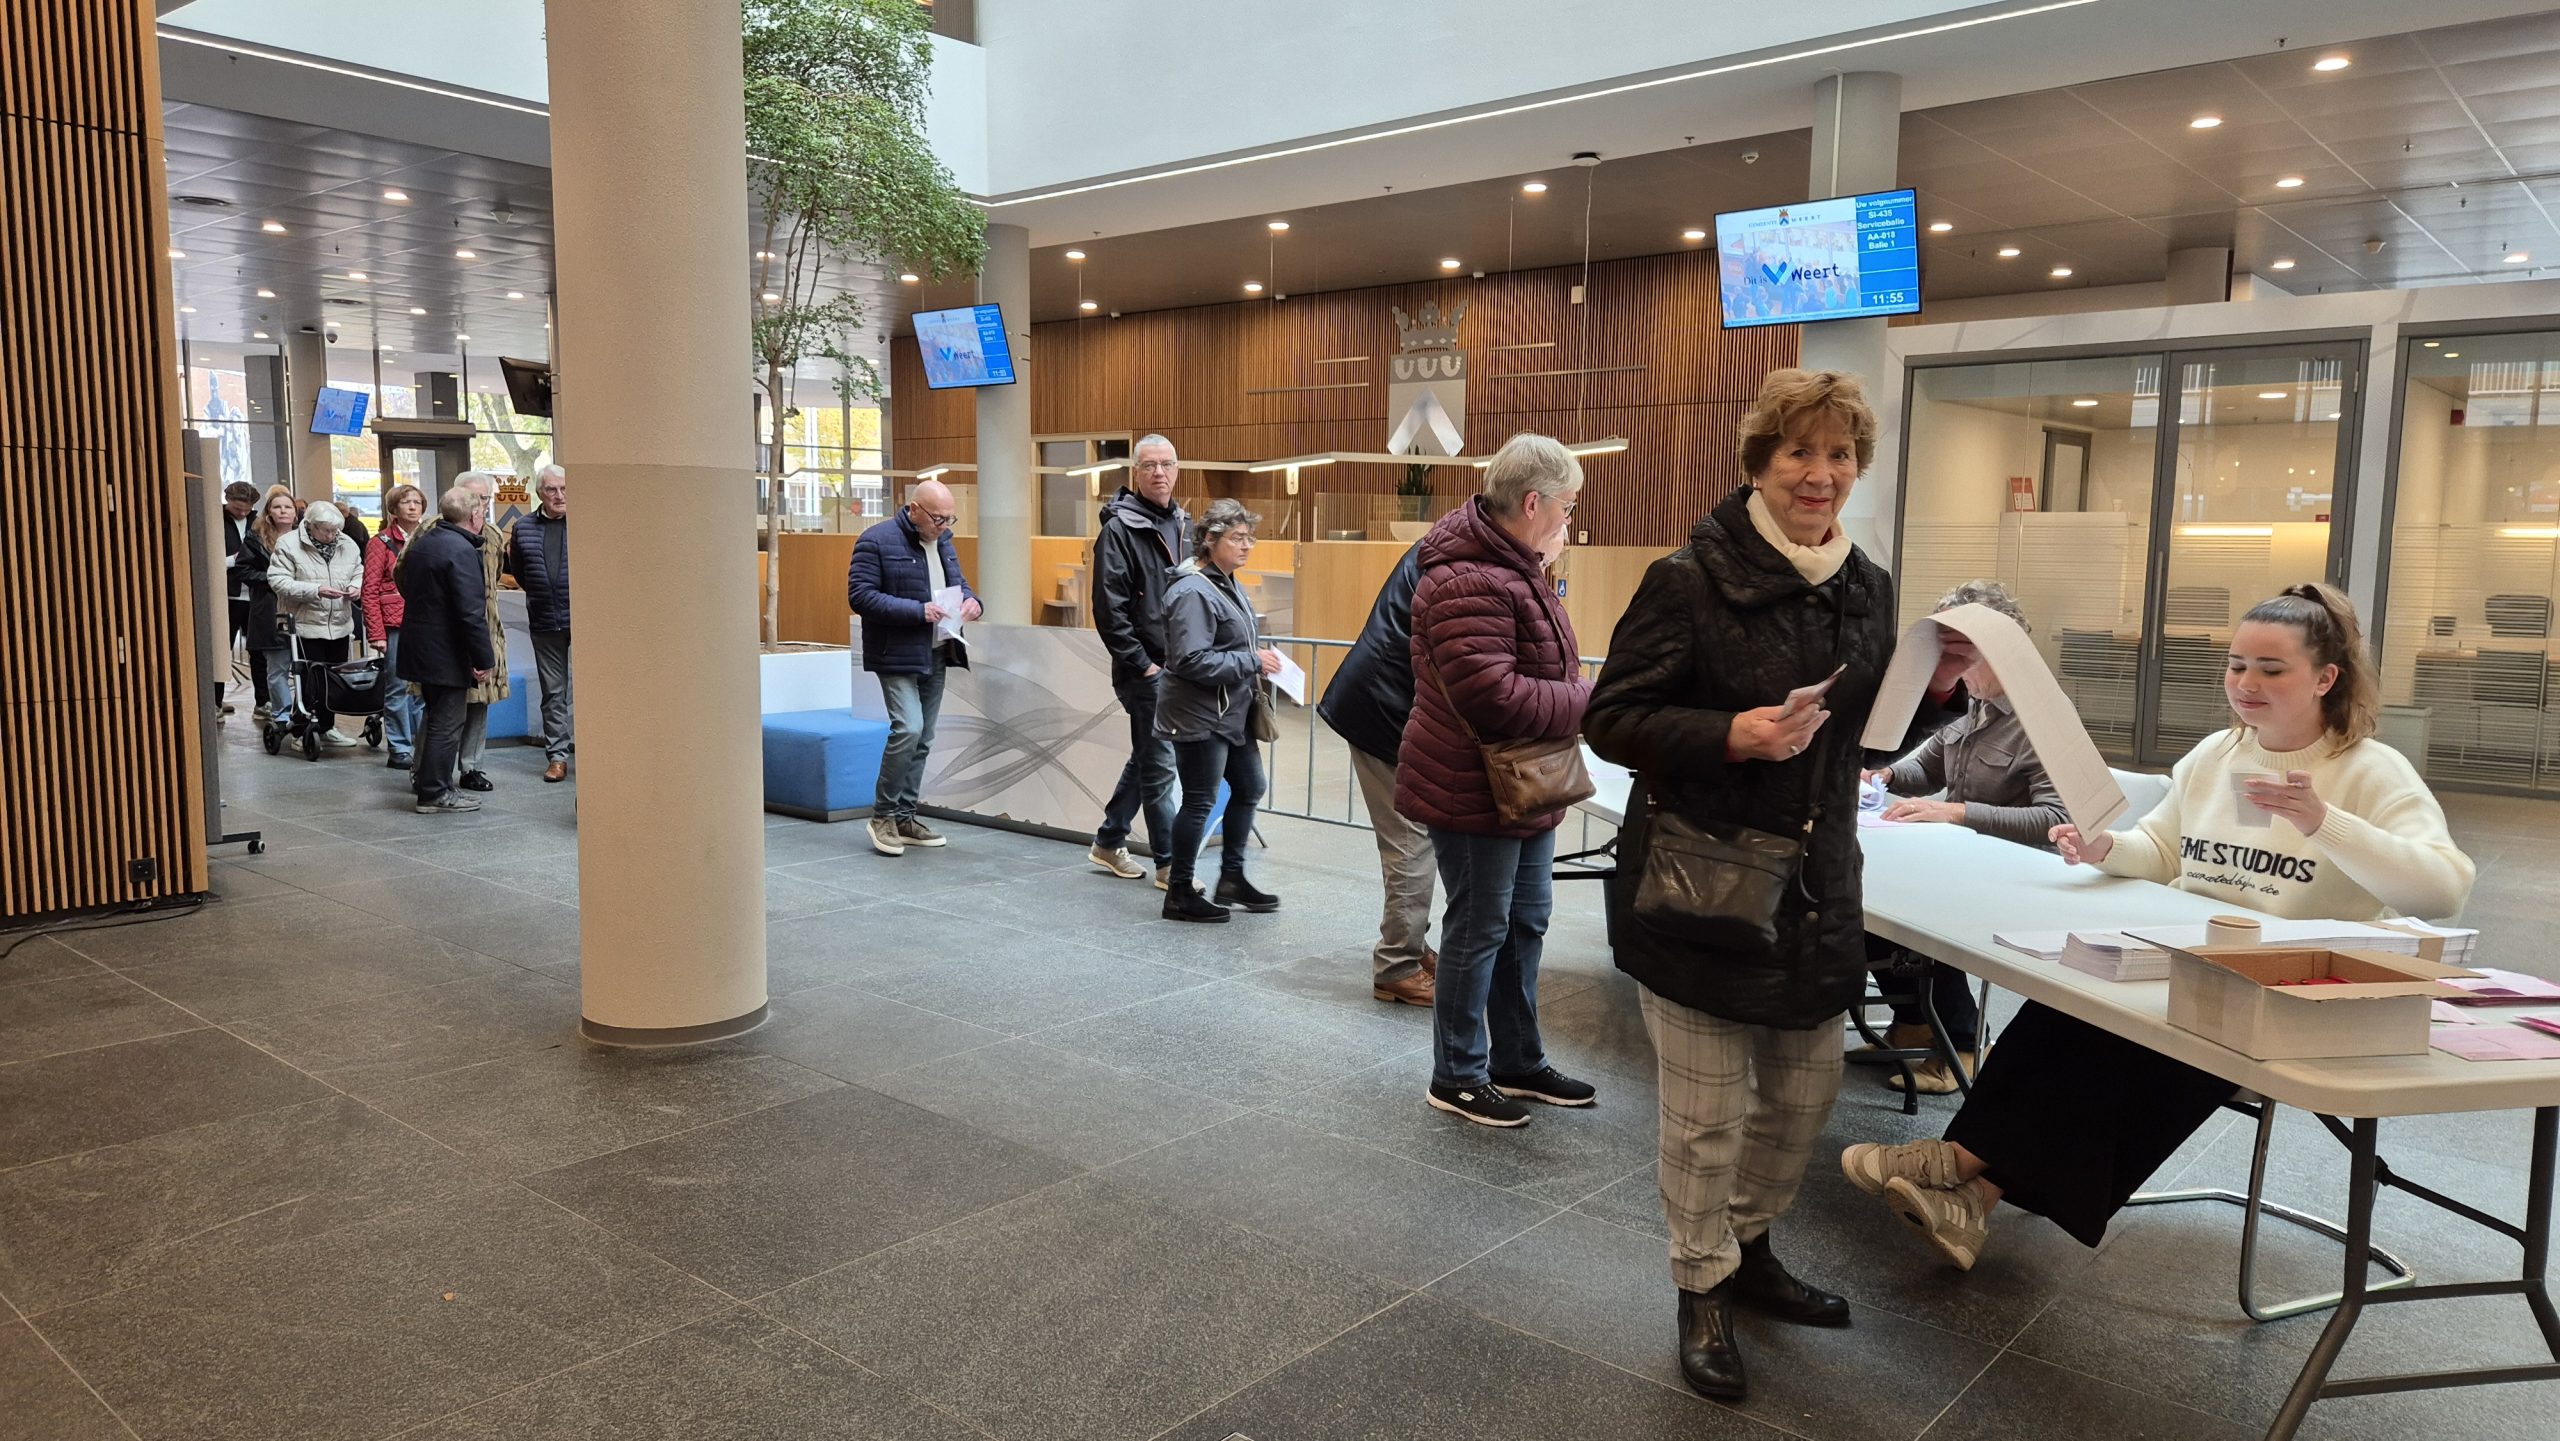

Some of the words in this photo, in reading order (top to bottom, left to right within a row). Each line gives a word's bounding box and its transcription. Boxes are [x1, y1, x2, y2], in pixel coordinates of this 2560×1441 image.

[1868, 241, 1889, 250] Balie
[1791, 263, 1840, 281] Weert
[1872, 291, 1904, 305] 11:55
[2212, 842, 2316, 883] STUDIOS
[2259, 884, 2281, 896] ice
